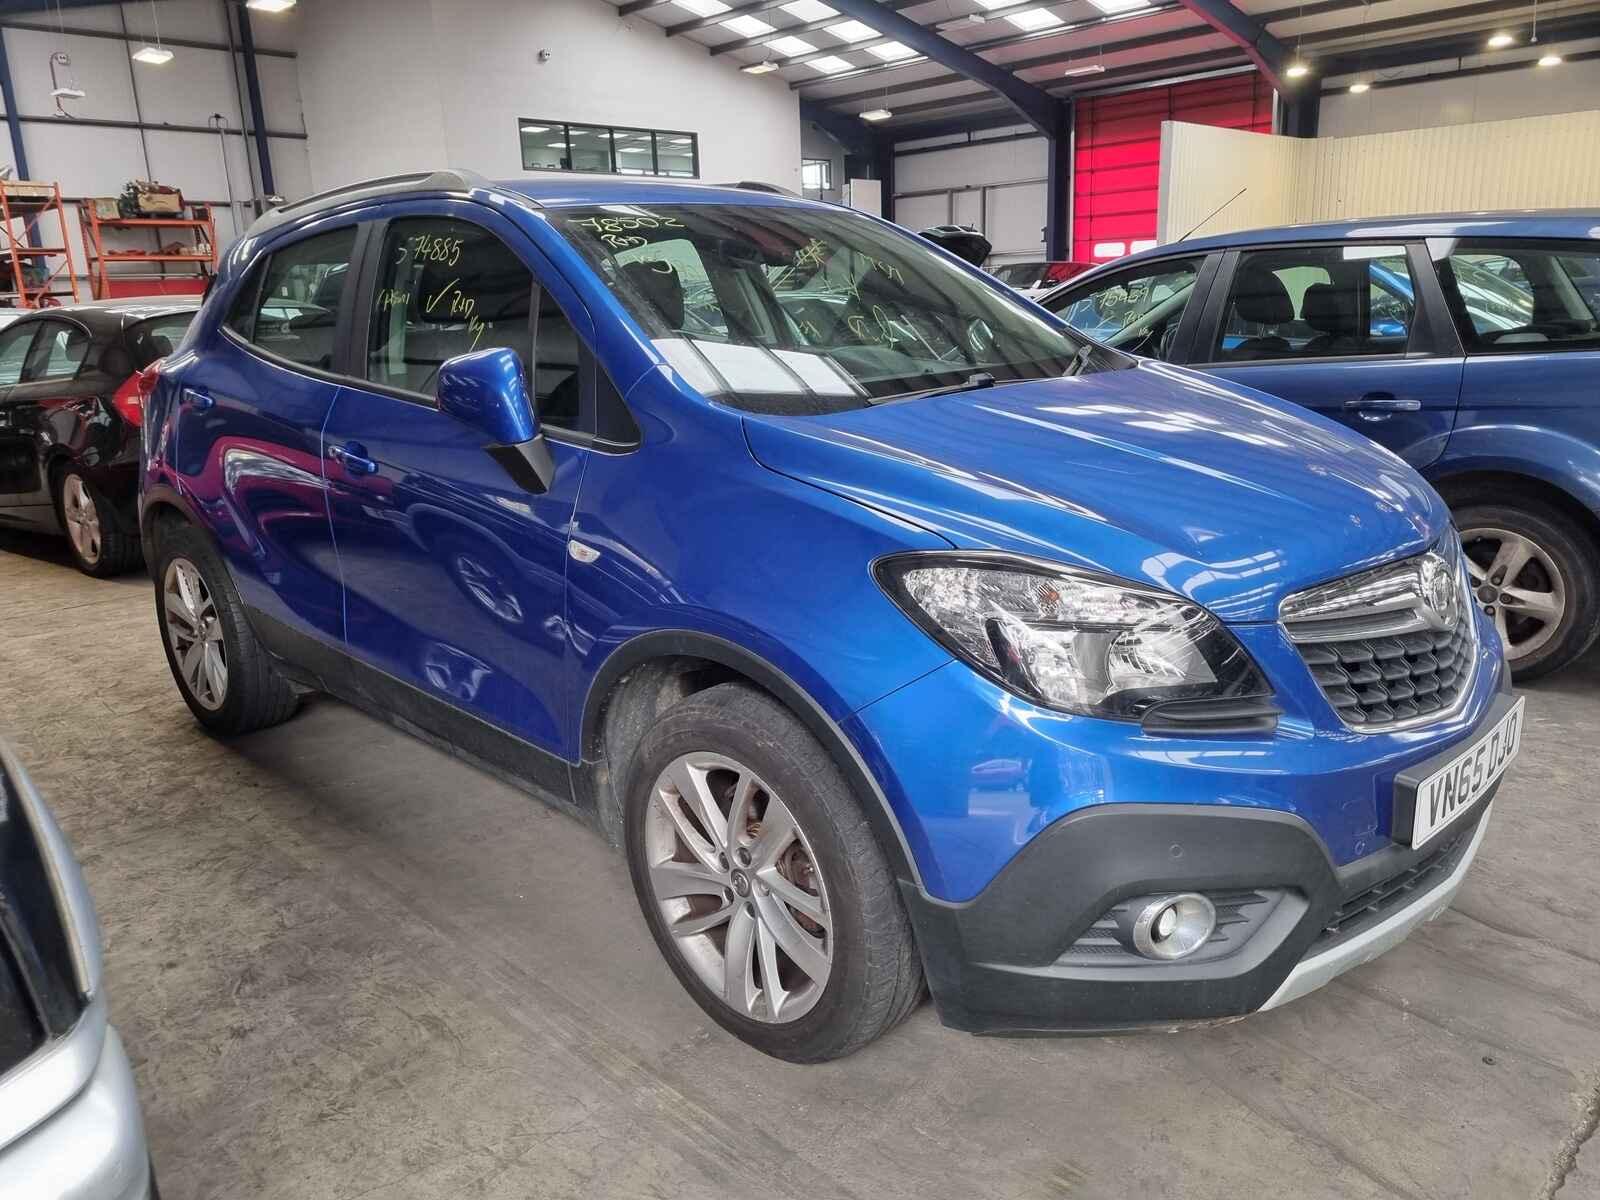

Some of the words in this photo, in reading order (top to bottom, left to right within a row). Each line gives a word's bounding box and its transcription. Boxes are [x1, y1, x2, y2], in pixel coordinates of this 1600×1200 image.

[567, 215, 686, 232] 78502
[414, 234, 464, 267] 74885
[1430, 743, 1486, 828] VN65
[1487, 711, 1518, 780] DJO
